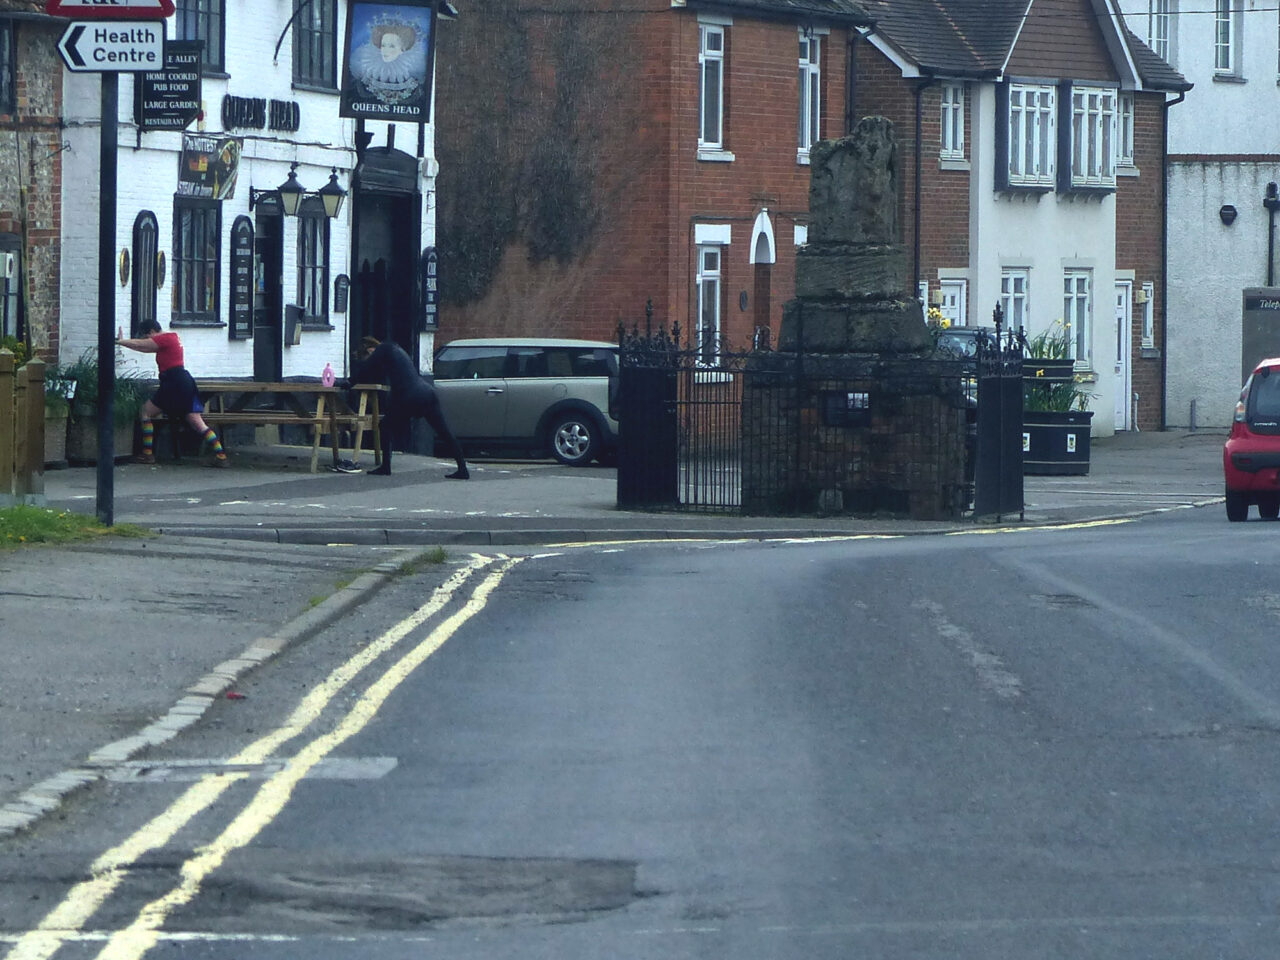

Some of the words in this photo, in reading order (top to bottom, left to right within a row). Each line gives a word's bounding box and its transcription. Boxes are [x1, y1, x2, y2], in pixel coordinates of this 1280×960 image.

[95, 28, 155, 43] Health
[93, 48, 156, 62] Centre
[175, 55, 198, 63] ALLEY
[146, 72, 165, 81] HOME
[168, 72, 197, 81] COOKED
[153, 83, 168, 91] PUB
[170, 83, 189, 91] FOOD
[144, 100, 168, 109] LARGE
[169, 100, 198, 109] GARDEN
[351, 102, 390, 113] QUEENS
[393, 105, 421, 115] HEAD
[221, 93, 266, 132] QUEENS
[268, 99, 300, 132] HEAD
